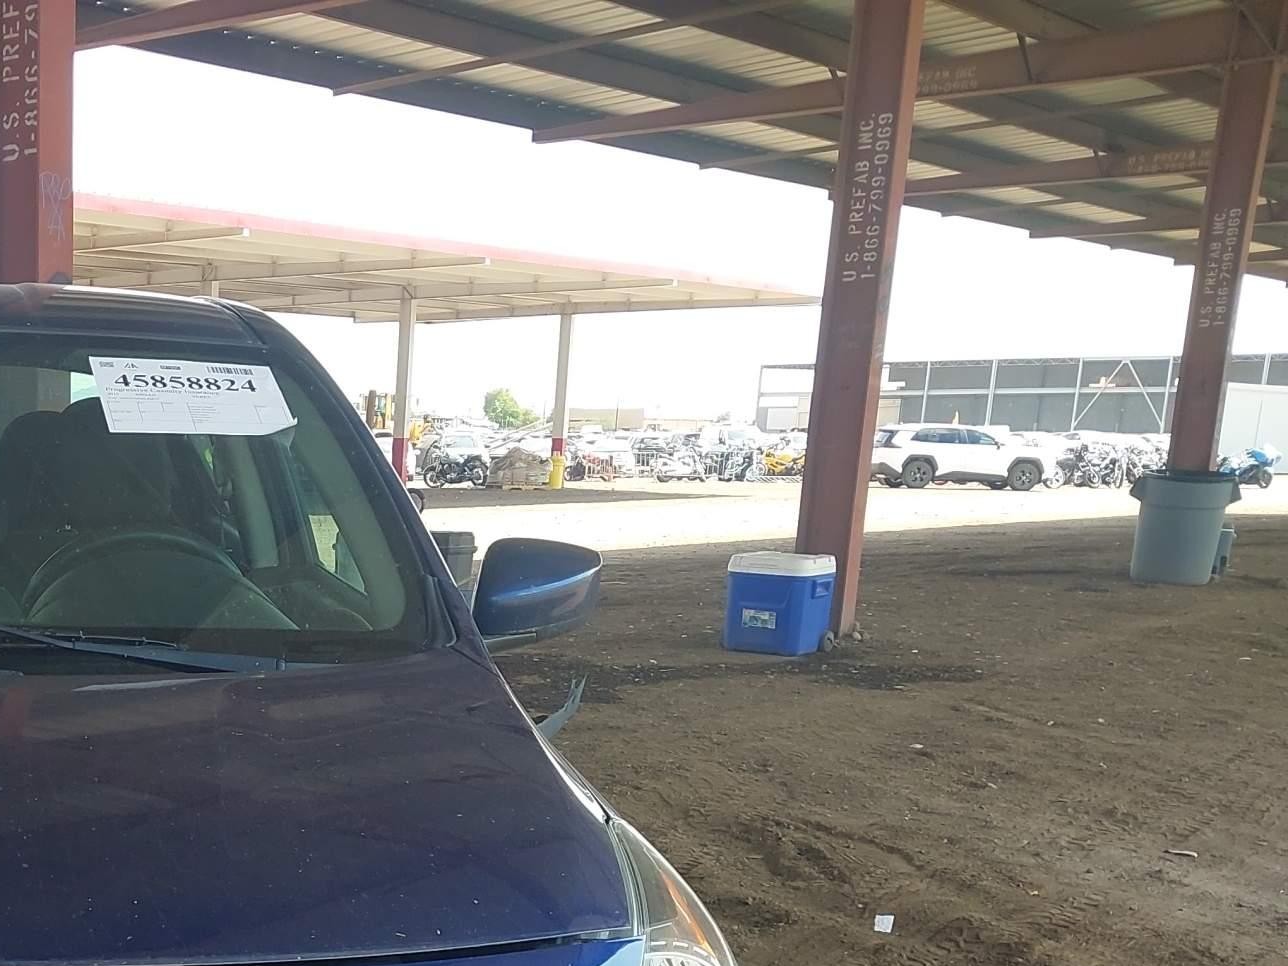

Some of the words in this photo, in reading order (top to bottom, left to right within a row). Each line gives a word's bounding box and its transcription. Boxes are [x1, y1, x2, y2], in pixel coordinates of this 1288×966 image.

[2, 2, 20, 83] PREF
[2, 102, 20, 162] U.S.
[858, 113, 876, 149] INC.
[848, 160, 870, 235] PREFAB
[860, 112, 894, 279] 1-866-799-0969
[1204, 242, 1223, 294] PREFAB
[1213, 207, 1242, 326] 1-866-799-0969
[114, 373, 256, 393] 45858824
